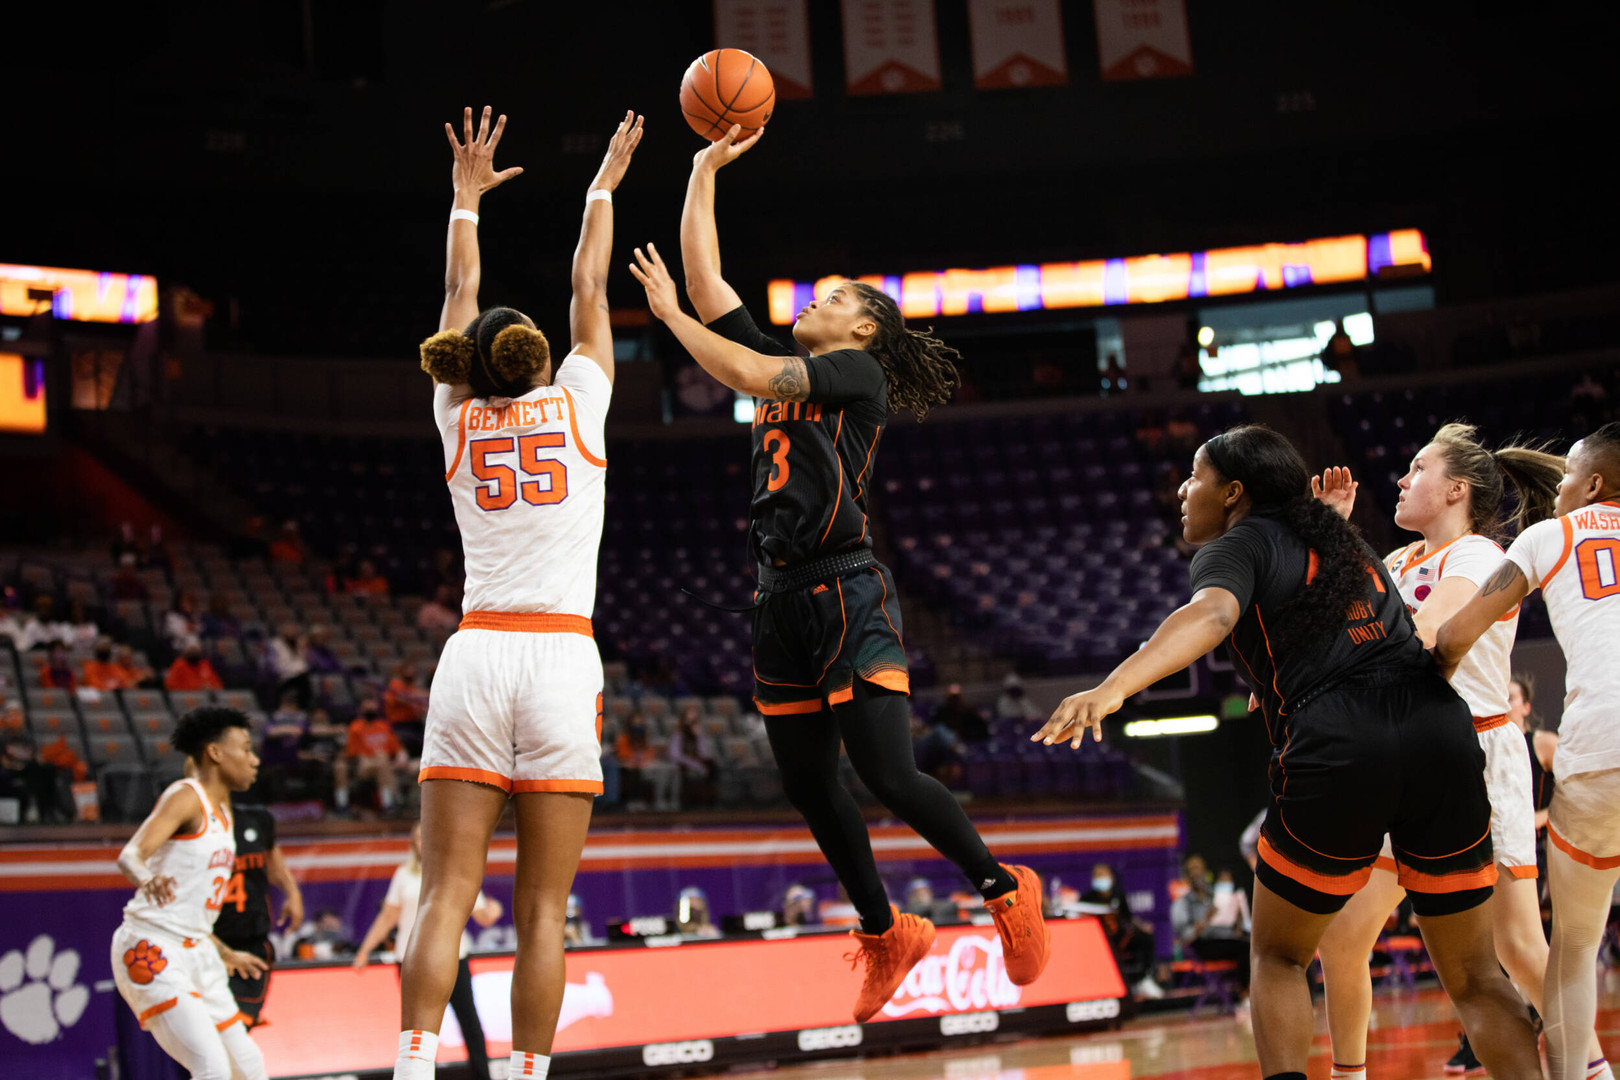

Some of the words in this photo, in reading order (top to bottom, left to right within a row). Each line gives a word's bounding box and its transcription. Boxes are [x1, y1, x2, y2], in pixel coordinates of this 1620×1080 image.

[468, 397, 564, 431] BENNETT
[470, 432, 568, 512] 55
[763, 428, 791, 492] 3
[1574, 510, 1620, 531] WASH
[1574, 537, 1620, 601] 0
[1347, 620, 1388, 645] UNITY
[642, 1040, 714, 1067] GEICO
